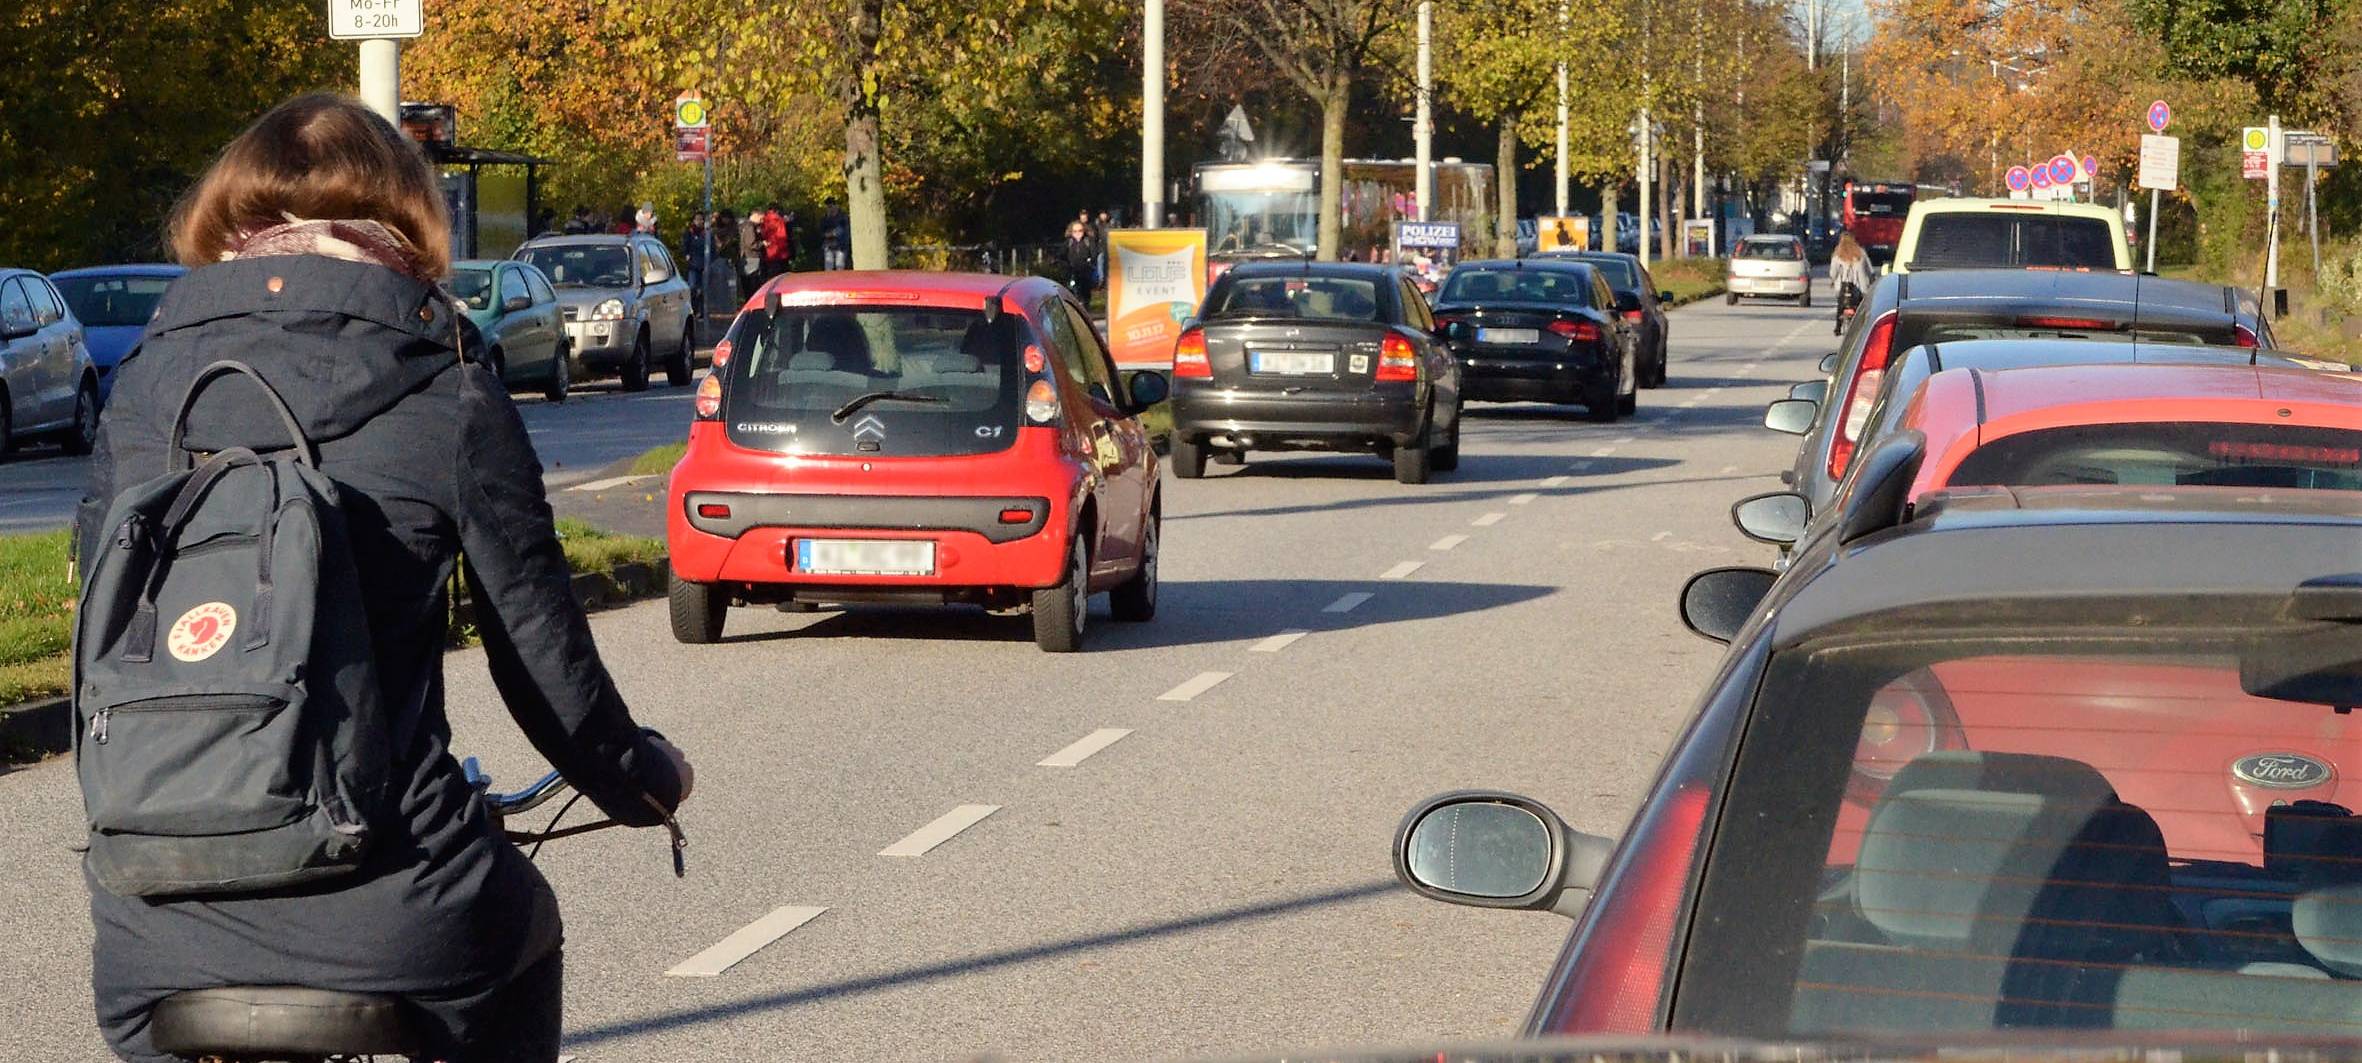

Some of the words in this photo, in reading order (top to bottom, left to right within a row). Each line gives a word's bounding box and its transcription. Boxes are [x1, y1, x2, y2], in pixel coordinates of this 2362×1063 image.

[350, 0, 400, 9] Mo-Fr
[354, 14, 399, 28] 8-20h
[1402, 225, 1456, 237] POLIZEI
[1137, 286, 1176, 295] EVENT
[1126, 322, 1166, 341] 10.11.17
[975, 426, 1002, 438] C1
[2253, 757, 2309, 780] Ford
